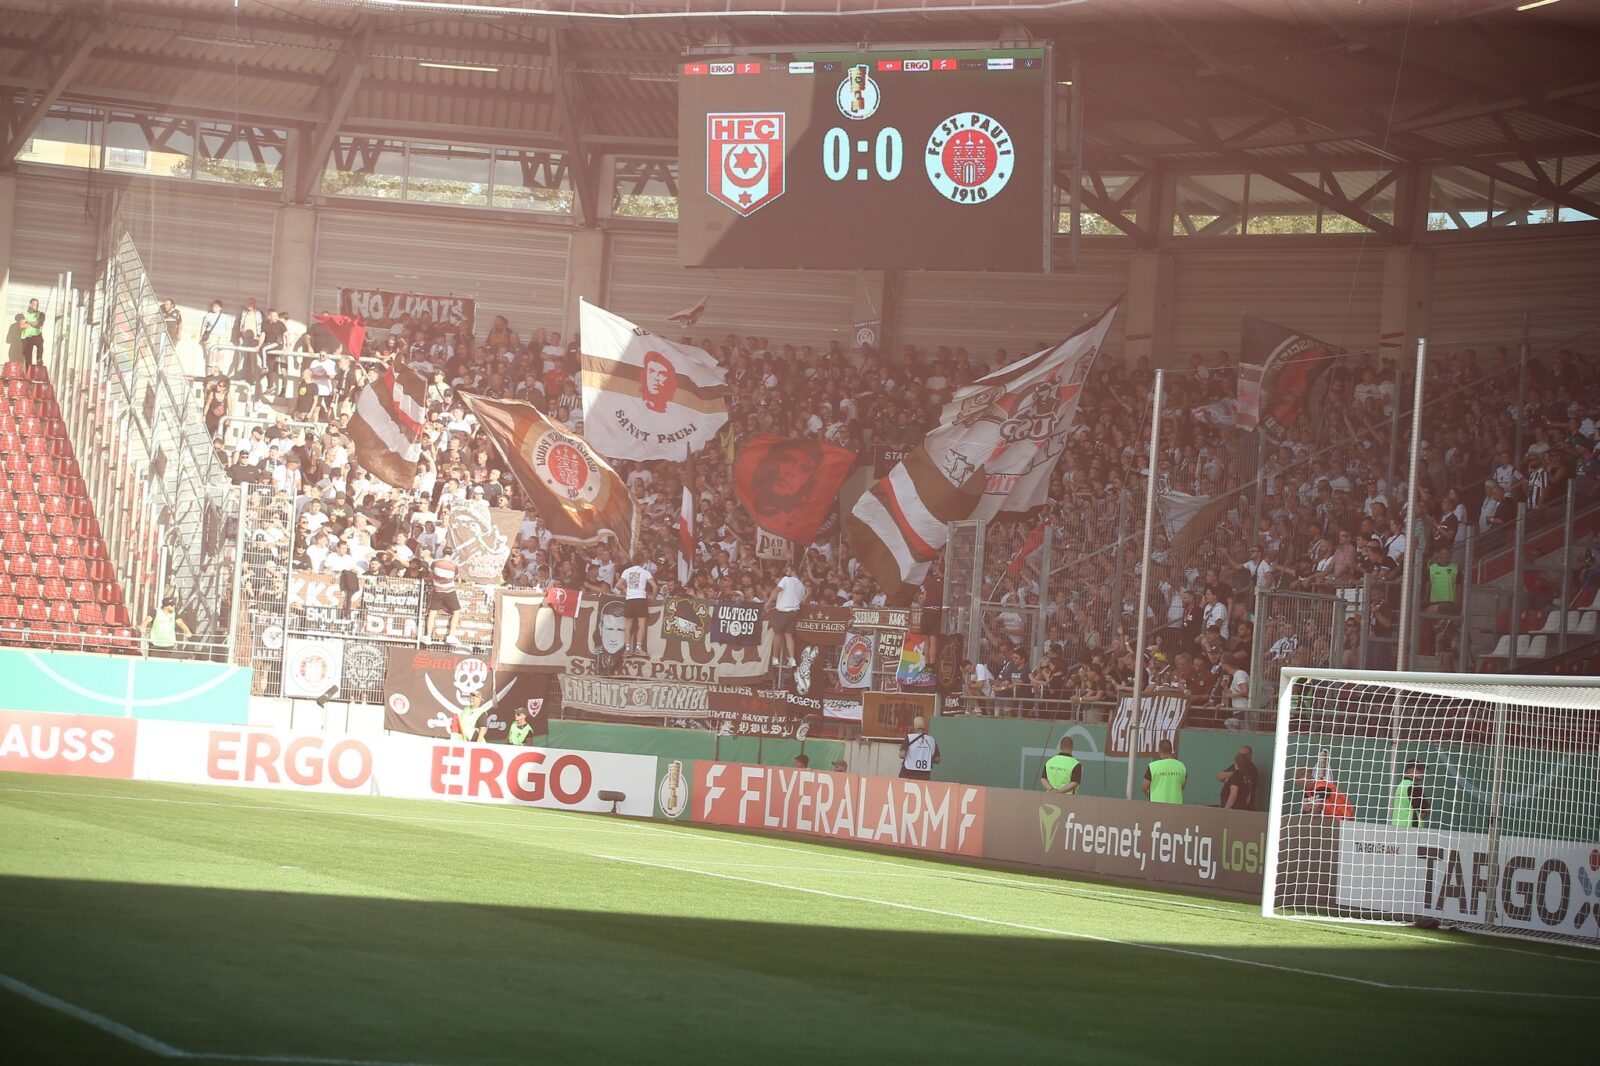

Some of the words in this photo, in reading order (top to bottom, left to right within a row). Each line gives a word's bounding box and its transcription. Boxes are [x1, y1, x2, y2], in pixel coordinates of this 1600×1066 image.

[711, 64, 734, 73] ERGO
[905, 61, 929, 70] ERGO
[714, 118, 776, 140] HFC
[927, 138, 945, 156] FC
[941, 116, 965, 135] ST.
[970, 114, 1013, 156] PAULI
[823, 126, 904, 182] 0:0
[950, 186, 988, 203] 1910
[350, 291, 385, 320] NO
[389, 296, 468, 327] LIMITS
[615, 410, 652, 443] SANKT
[656, 423, 699, 444] PAULI
[306, 606, 360, 627] SKULS
[718, 605, 759, 622] ULTRAS
[570, 658, 647, 677] SAKT
[650, 662, 717, 683] PAULI
[564, 677, 629, 709] ENFANTS
[708, 684, 754, 697] WILDER
[757, 688, 789, 700] WEST
[787, 693, 821, 710] BOGEYS
[741, 712, 771, 723] SANKT
[0, 723, 116, 765] AUSS
[206, 729, 374, 789] ERGO
[915, 759, 928, 770] 08
[429, 745, 592, 805] ERGO
[738, 767, 951, 850] FLYERALARM
[1064, 812, 1147, 871] freenet,
[1151, 821, 1218, 880] fertig,
[1221, 828, 1266, 875] los!
[1416, 845, 1571, 926] TARGO
